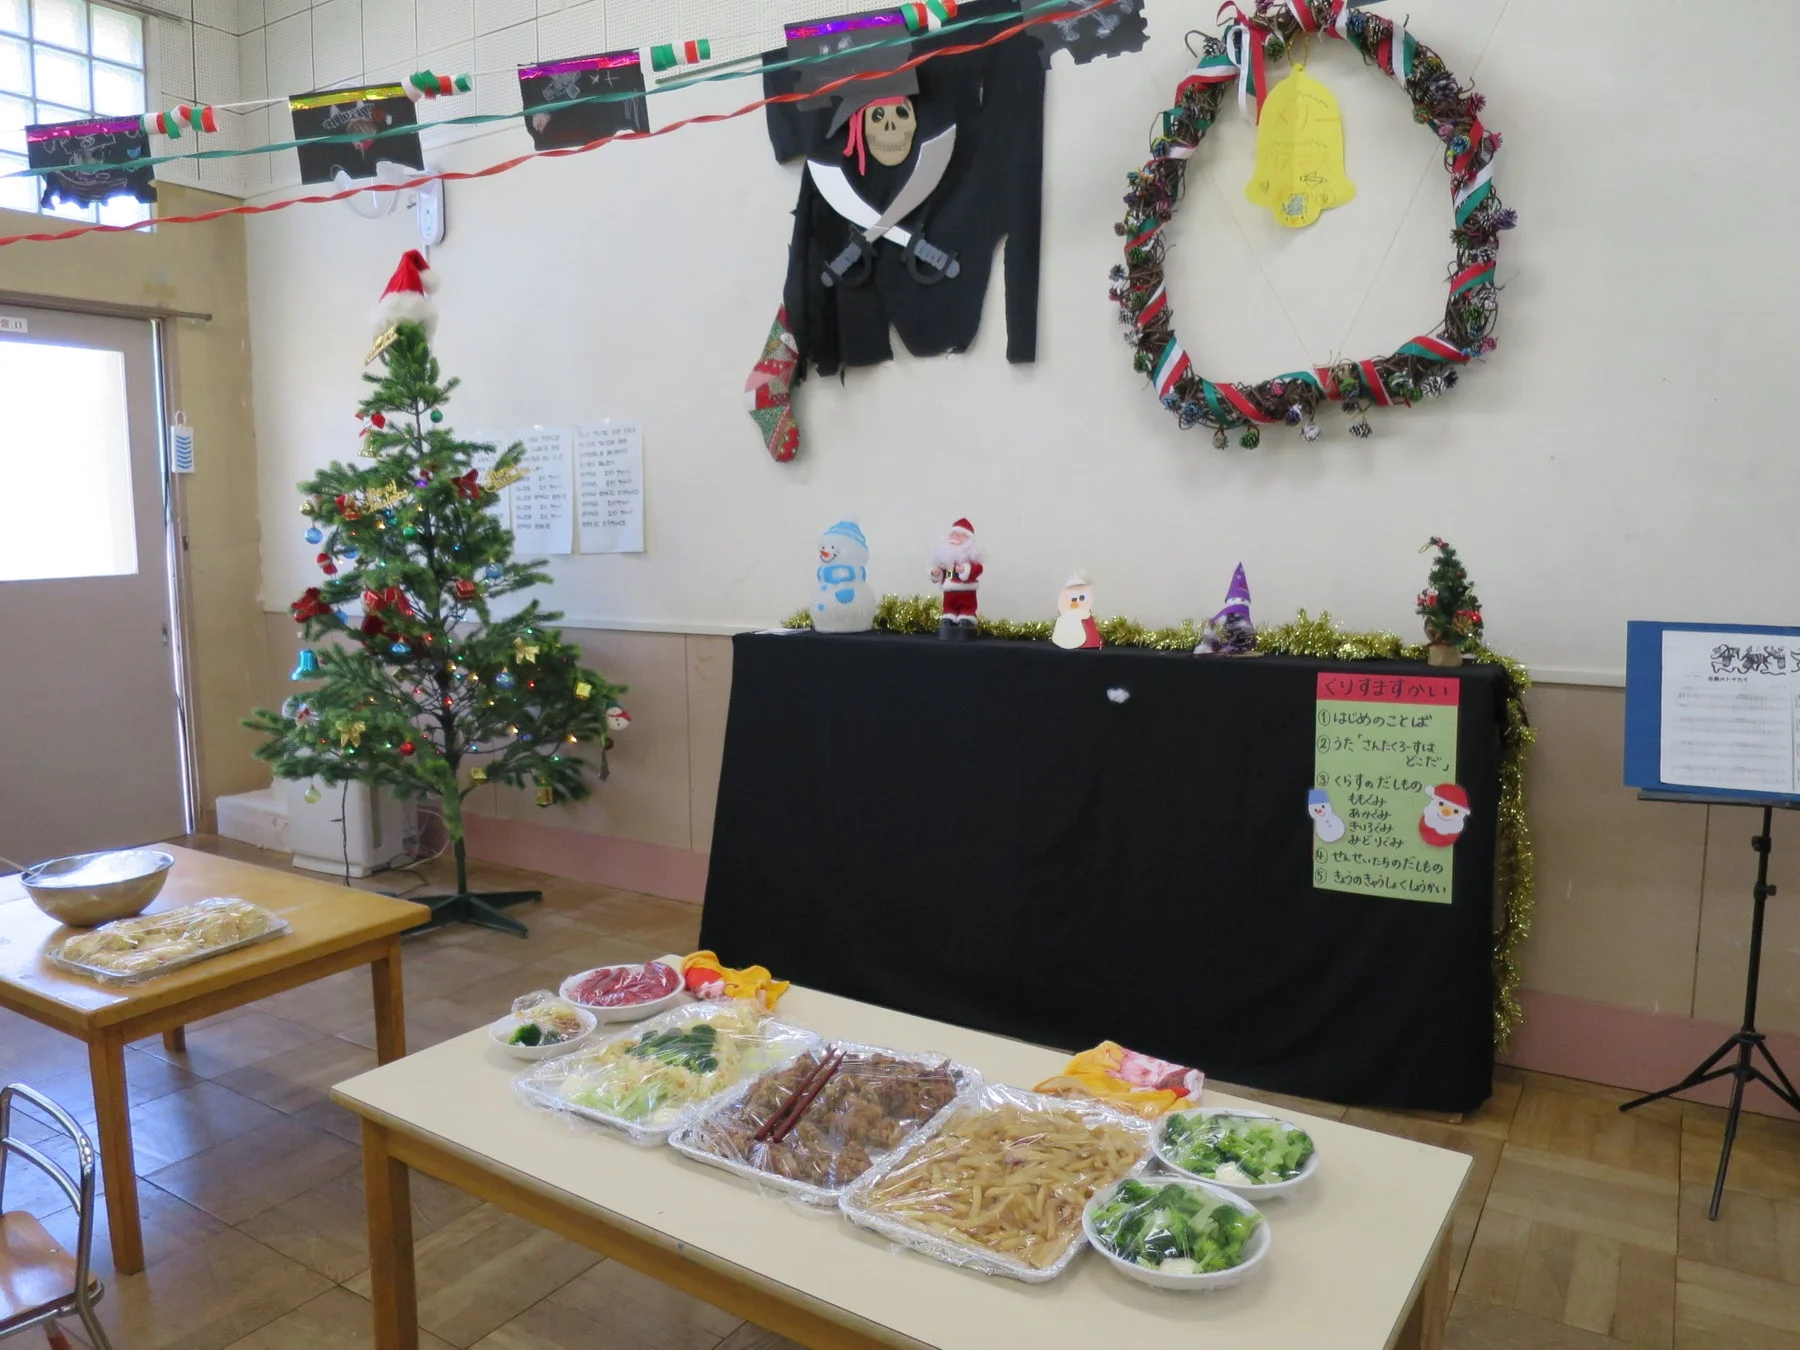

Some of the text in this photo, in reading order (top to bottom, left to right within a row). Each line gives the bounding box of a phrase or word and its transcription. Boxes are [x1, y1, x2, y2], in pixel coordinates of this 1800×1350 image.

[1325, 678, 1448, 697] くりすますかい
